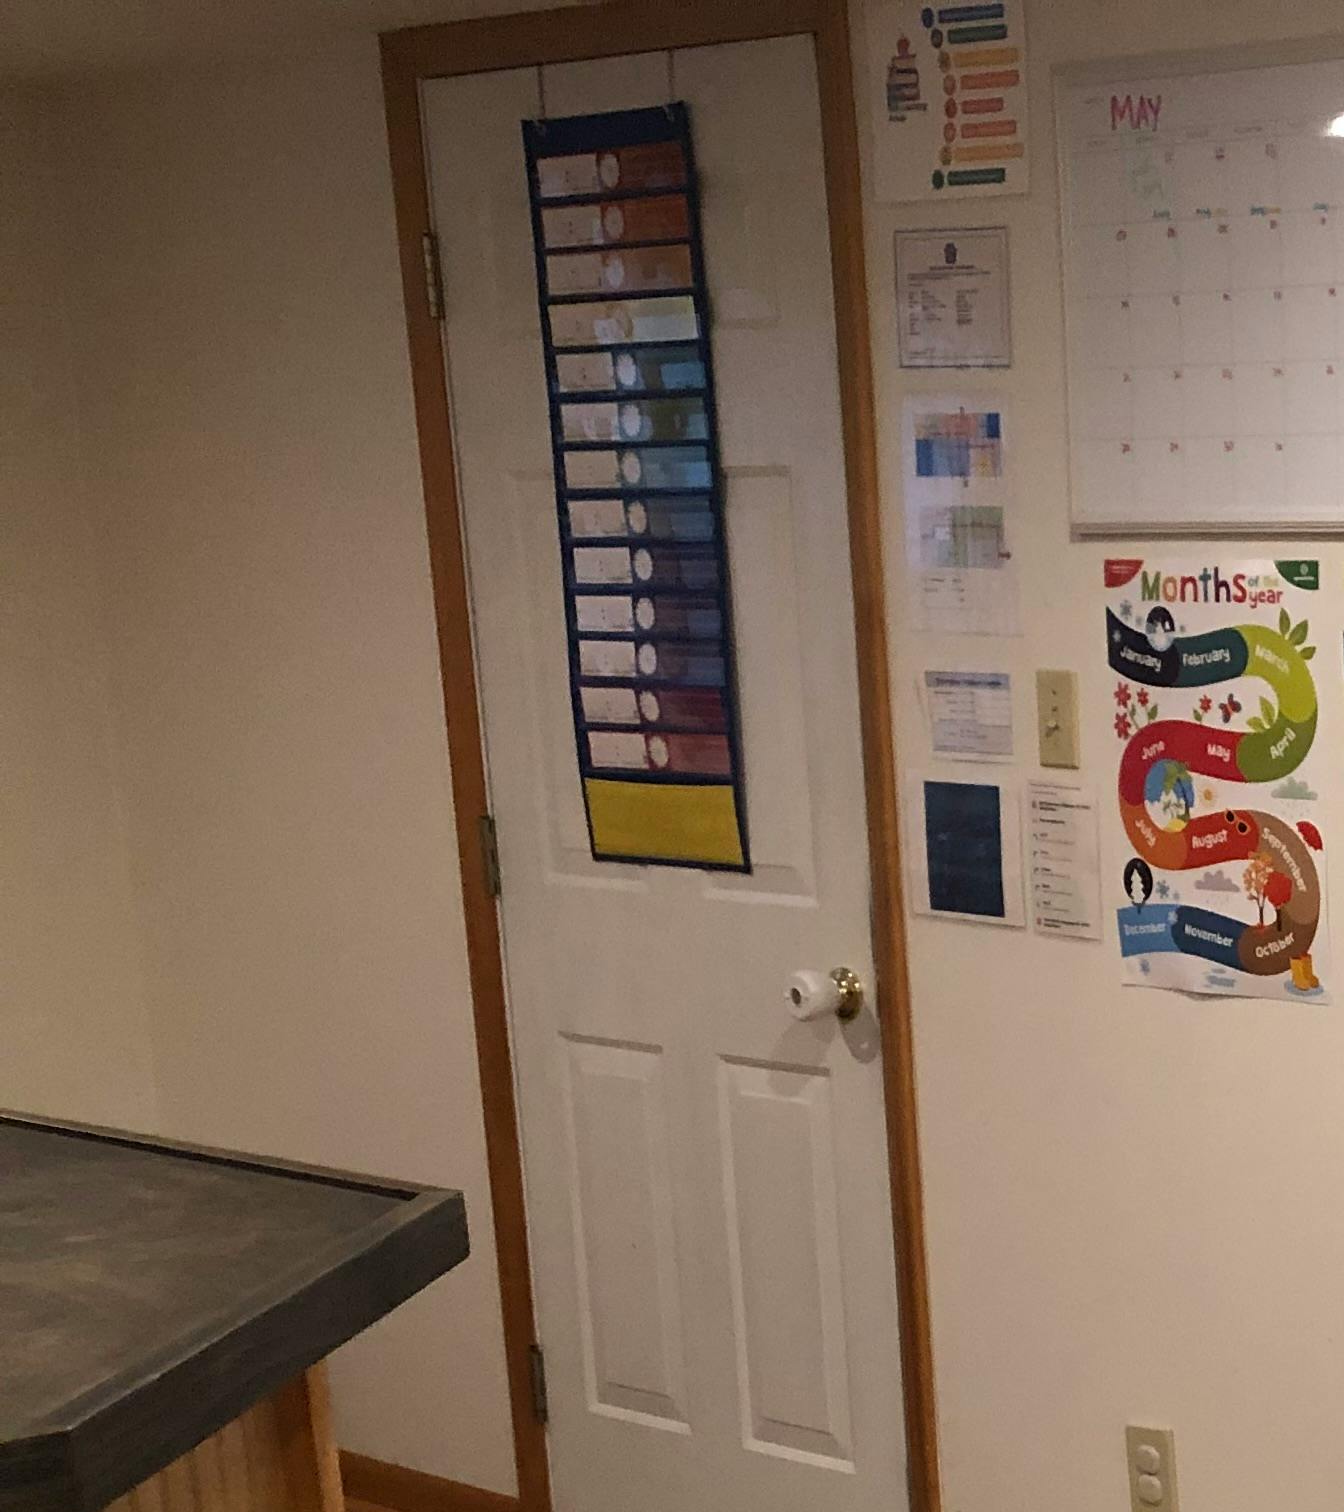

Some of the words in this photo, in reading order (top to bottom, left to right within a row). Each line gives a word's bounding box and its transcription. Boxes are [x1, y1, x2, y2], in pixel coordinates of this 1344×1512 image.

[1110, 94, 1162, 131] MAY
[1141, 567, 1247, 603] Months
[1249, 589, 1283, 608] year
[1120, 647, 1162, 672] January
[1182, 649, 1231, 667] February
[1141, 741, 1165, 759] June
[1207, 743, 1231, 762] May
[1269, 728, 1297, 760] April
[1192, 829, 1228, 849] August
[1261, 827, 1307, 892] September
[1184, 924, 1234, 947] November
[1255, 932, 1294, 958] October
